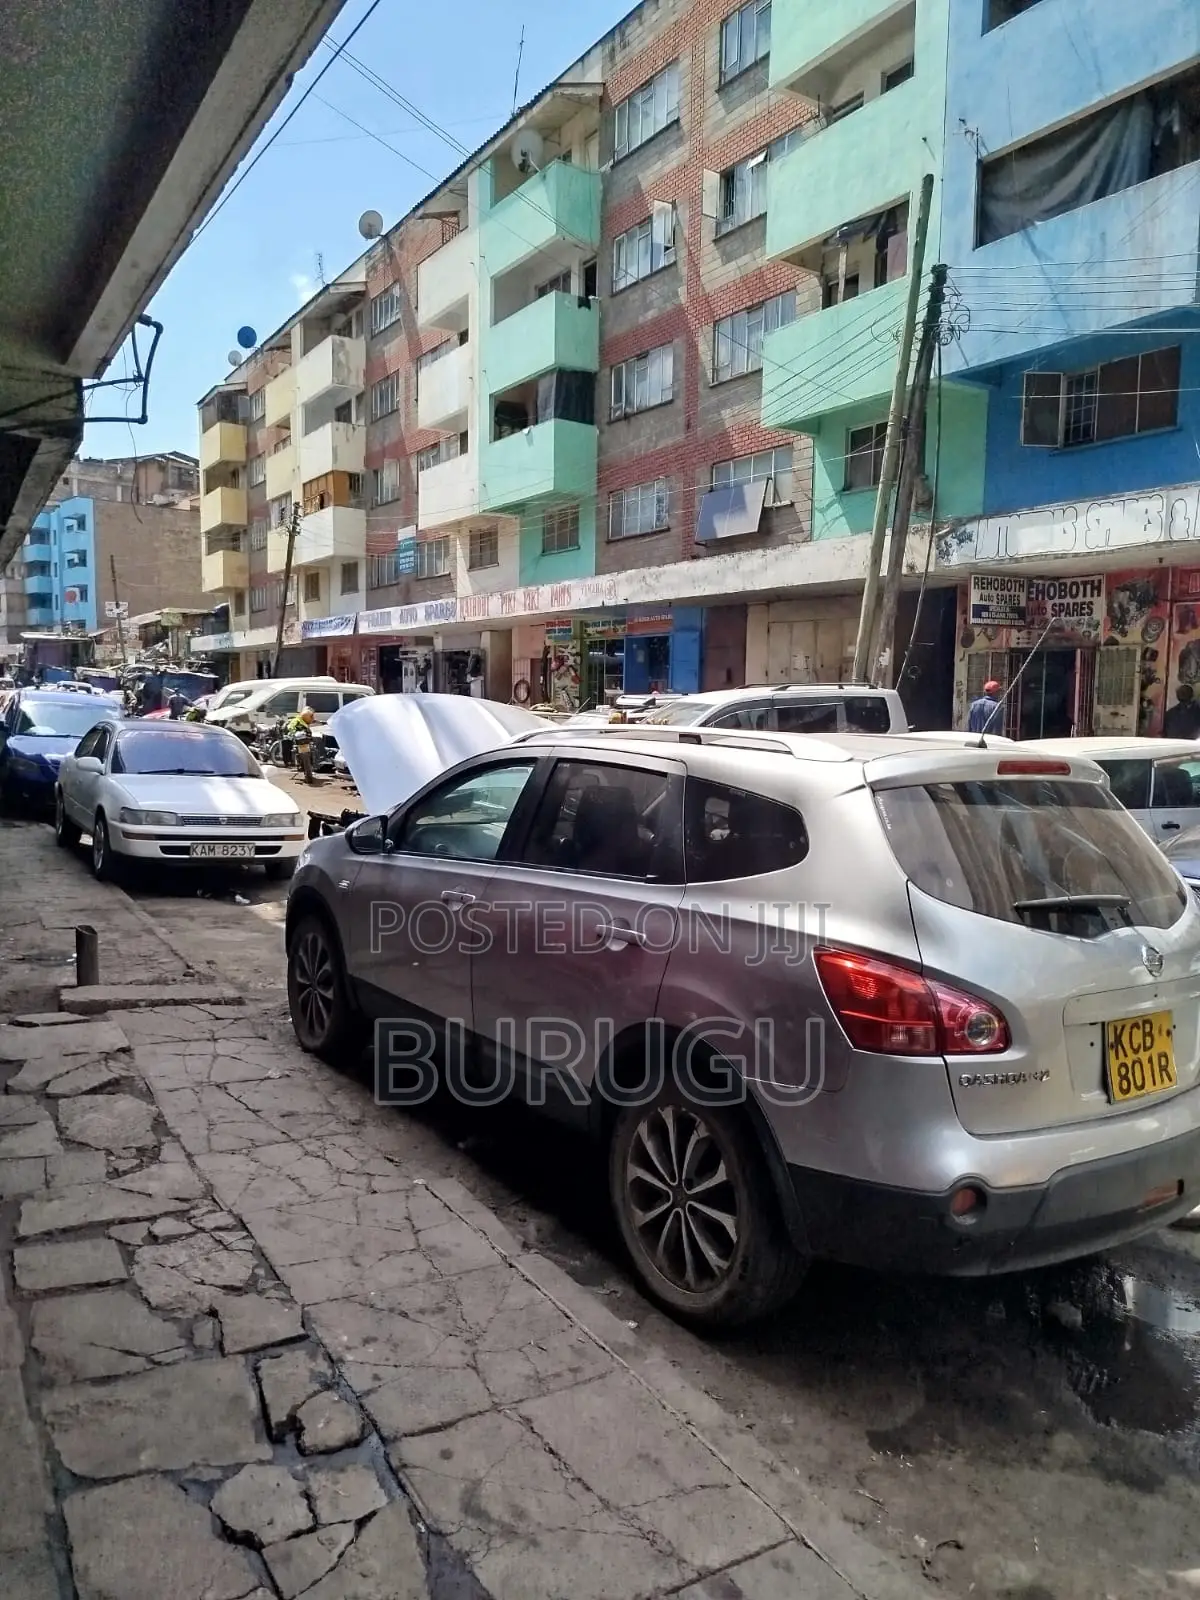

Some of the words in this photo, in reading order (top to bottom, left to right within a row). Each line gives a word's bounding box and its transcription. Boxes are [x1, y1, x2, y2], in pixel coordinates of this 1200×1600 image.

[973, 576, 1025, 592] REHOBOTH
[1027, 579, 1101, 601] EHOBOTH
[996, 593, 1021, 606] SPARES
[1051, 601, 1094, 618] SPARES
[192, 845, 216, 856] KAM
[222, 845, 254, 856] 823Y
[1112, 1018, 1154, 1060] KCB
[1117, 1051, 1173, 1096] 801R
